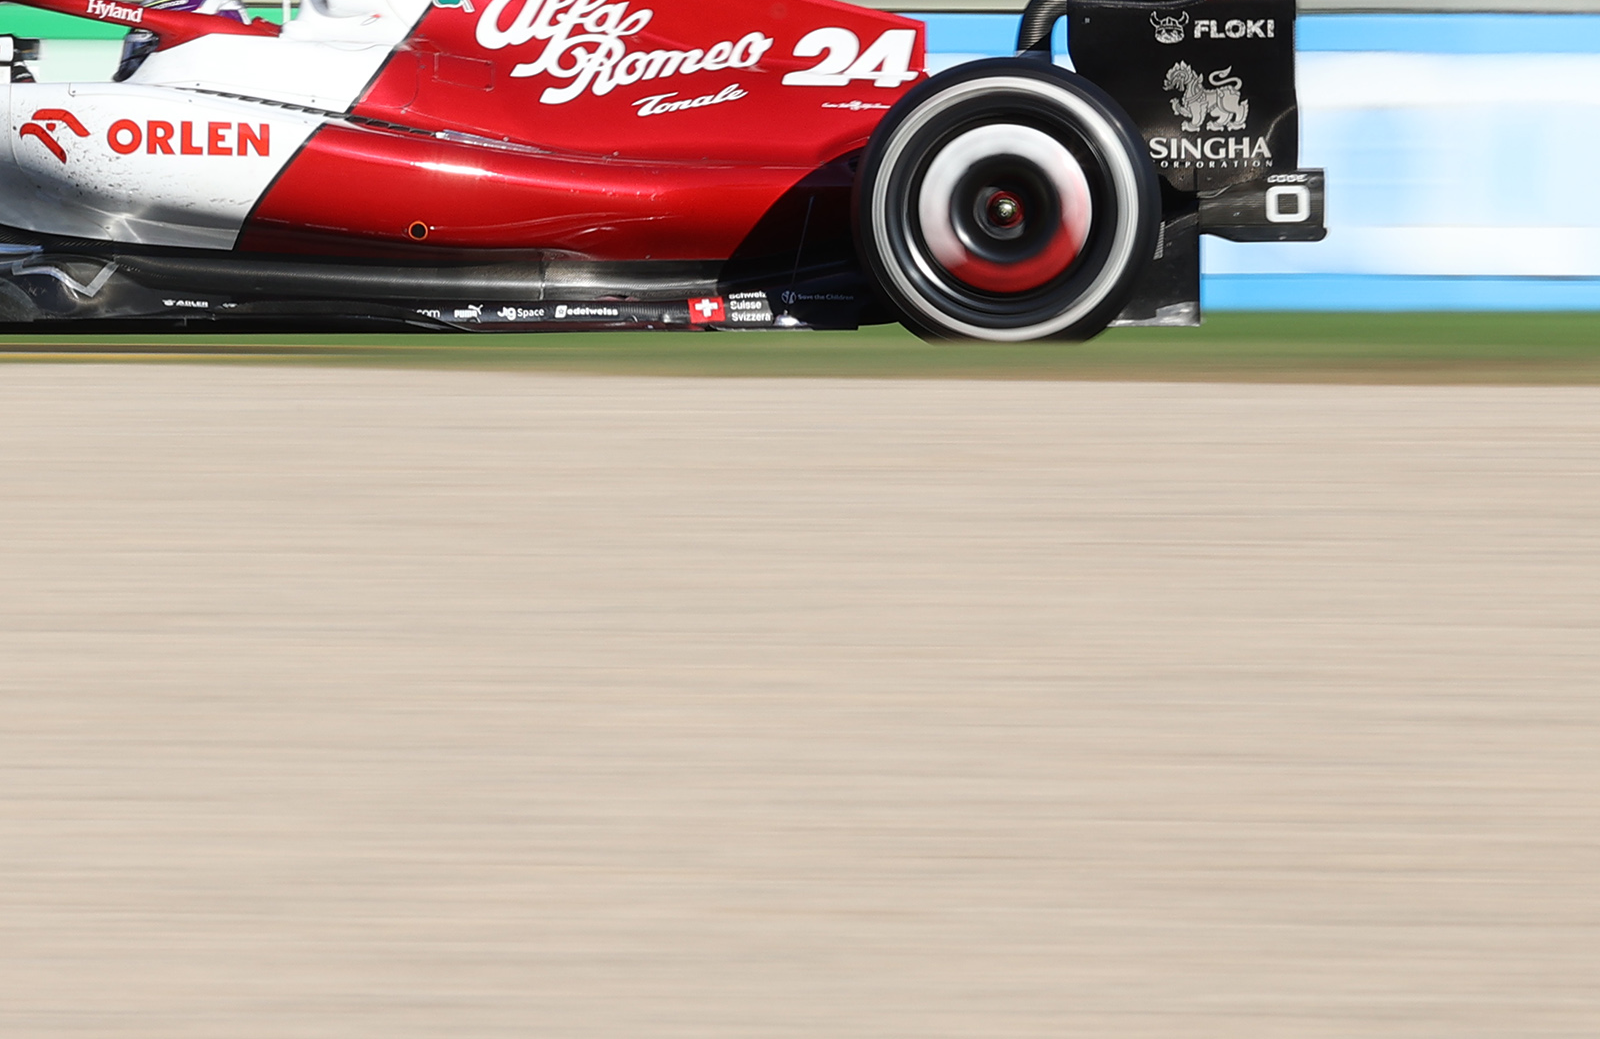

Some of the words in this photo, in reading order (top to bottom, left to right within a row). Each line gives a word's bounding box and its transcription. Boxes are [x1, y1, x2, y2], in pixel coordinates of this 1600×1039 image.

[1193, 19, 1275, 39] FLOKI
[539, 31, 775, 105] Romeo
[781, 27, 920, 88] 24
[631, 83, 749, 117] Tonale
[106, 118, 271, 157] ORLEN
[1149, 136, 1272, 160] SINGHA
[1153, 159, 1273, 169] ORPORATION
[730, 300, 762, 310] Suisse
[731, 311, 771, 322] Svizzera
